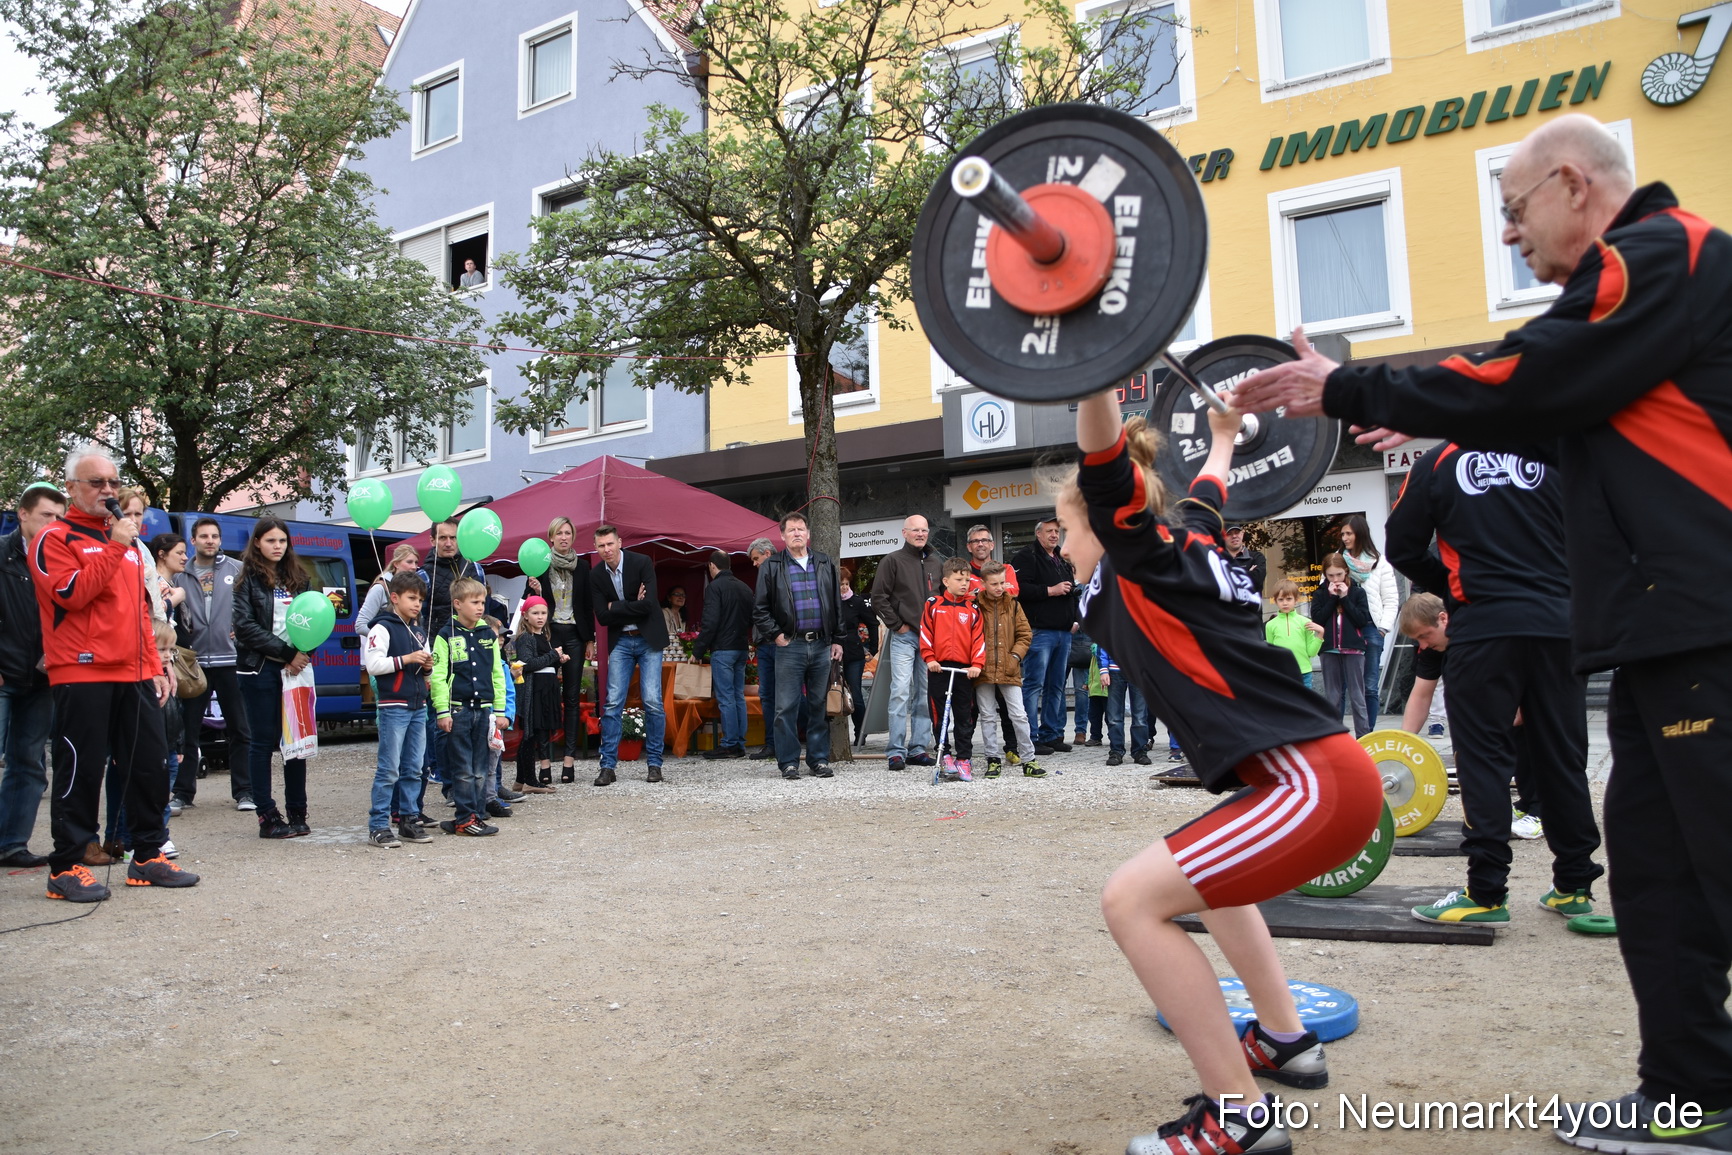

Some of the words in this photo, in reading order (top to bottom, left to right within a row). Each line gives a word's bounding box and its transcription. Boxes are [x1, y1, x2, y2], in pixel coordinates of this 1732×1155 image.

[1185, 148, 1235, 182] ER
[1259, 60, 1612, 171] IMMOBILIEN
[965, 214, 994, 309] ELEIK
[1100, 195, 1142, 315] ELEIKO
[1387, 451, 1423, 468] FAS
[427, 477, 453, 489] AOK
[1304, 497, 1329, 506] Make
[1331, 495, 1343, 504] up
[848, 529, 885, 539] Dauerhafte
[848, 538, 899, 548] Haarentfernung
[287, 611, 313, 628] AOK
[310, 650, 360, 666] ti-bus.de
[1366, 739, 1425, 766] ELEIKO
[1423, 783, 1437, 797] 15
[1315, 1000, 1338, 1008] 20
